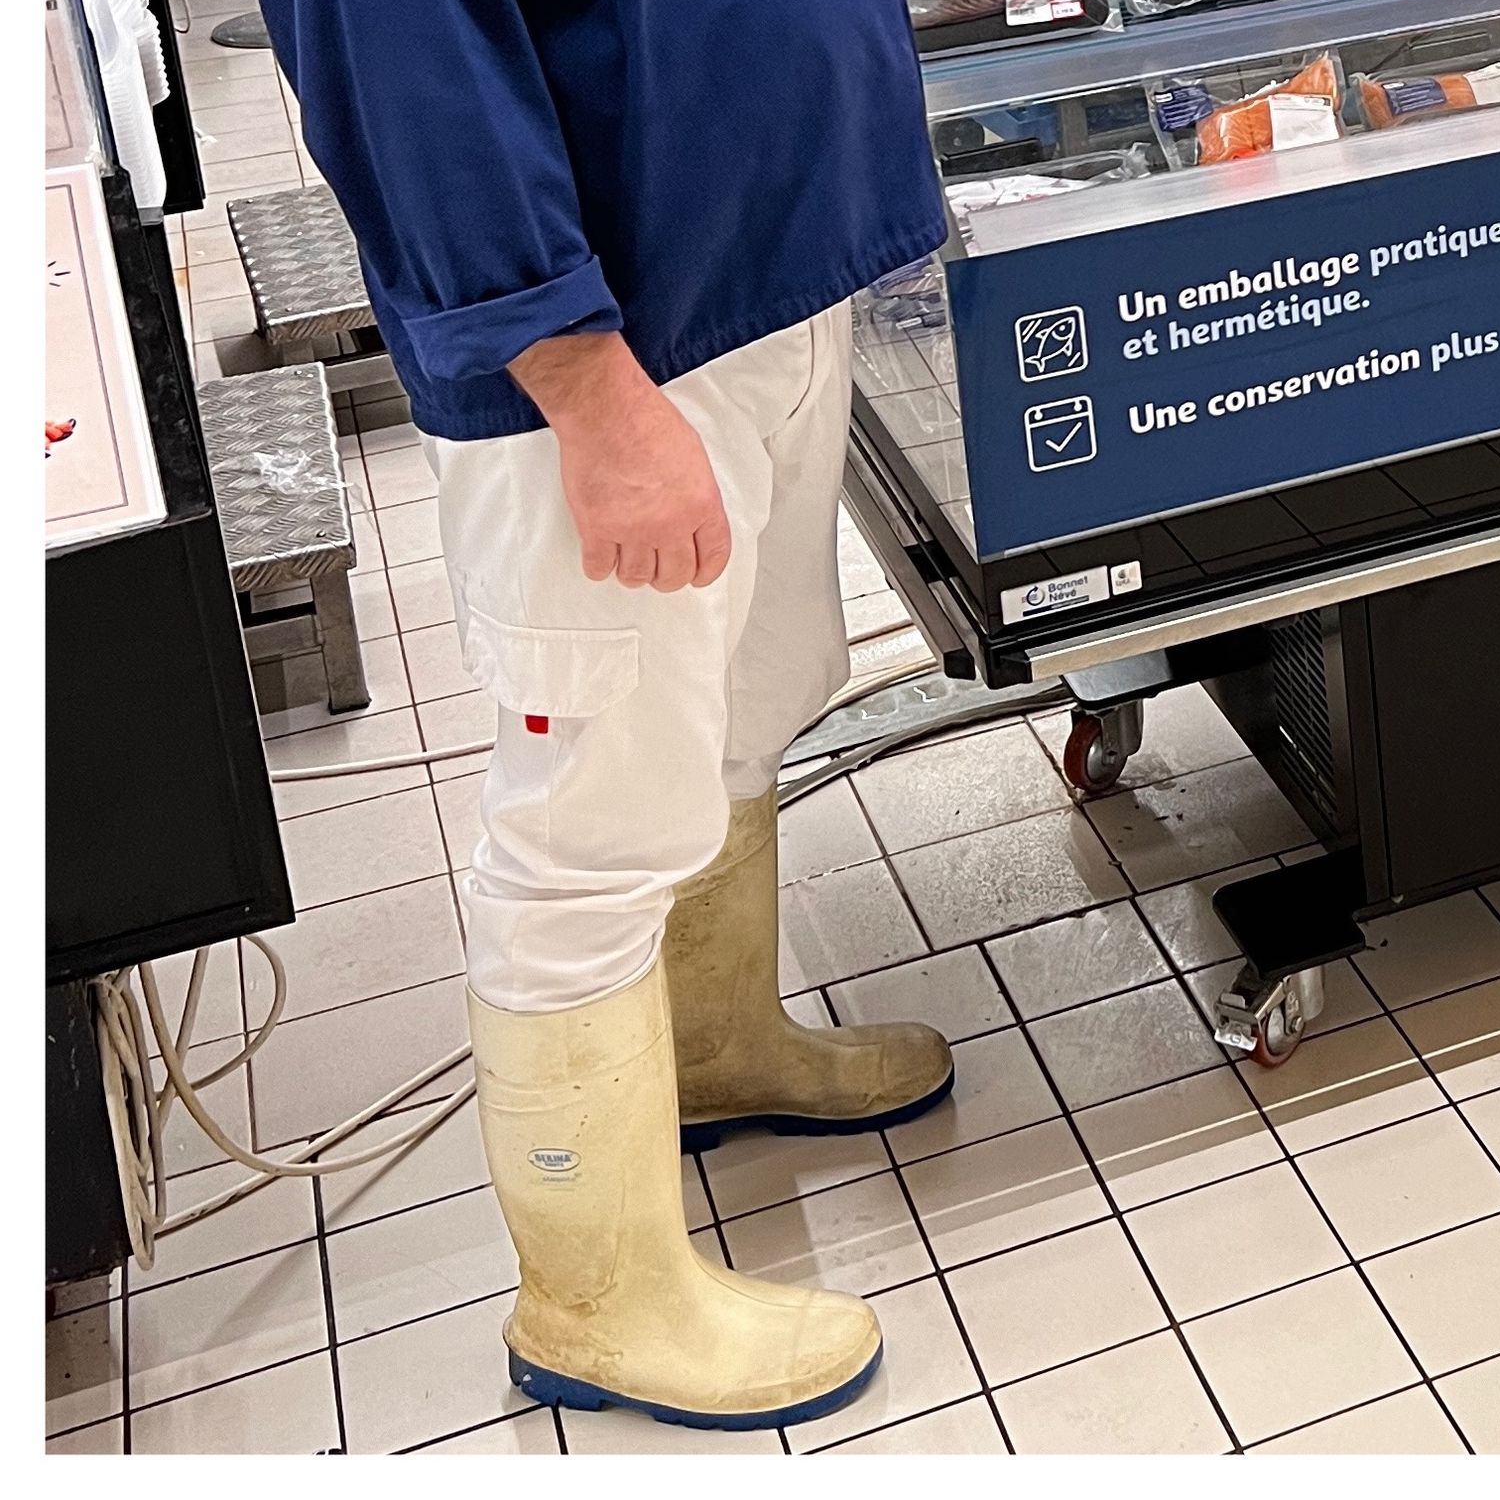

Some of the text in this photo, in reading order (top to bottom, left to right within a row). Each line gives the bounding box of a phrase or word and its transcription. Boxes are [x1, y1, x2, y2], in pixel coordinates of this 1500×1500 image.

[1119, 292, 1166, 321] Un
[1179, 254, 1360, 315] emballage
[1124, 281, 1369, 359] et hermétique.
[1130, 402, 1196, 433] Une
[1208, 350, 1419, 415] conservation
[1432, 332, 1498, 371] plus
[1048, 576, 1088, 593] Bonnet
